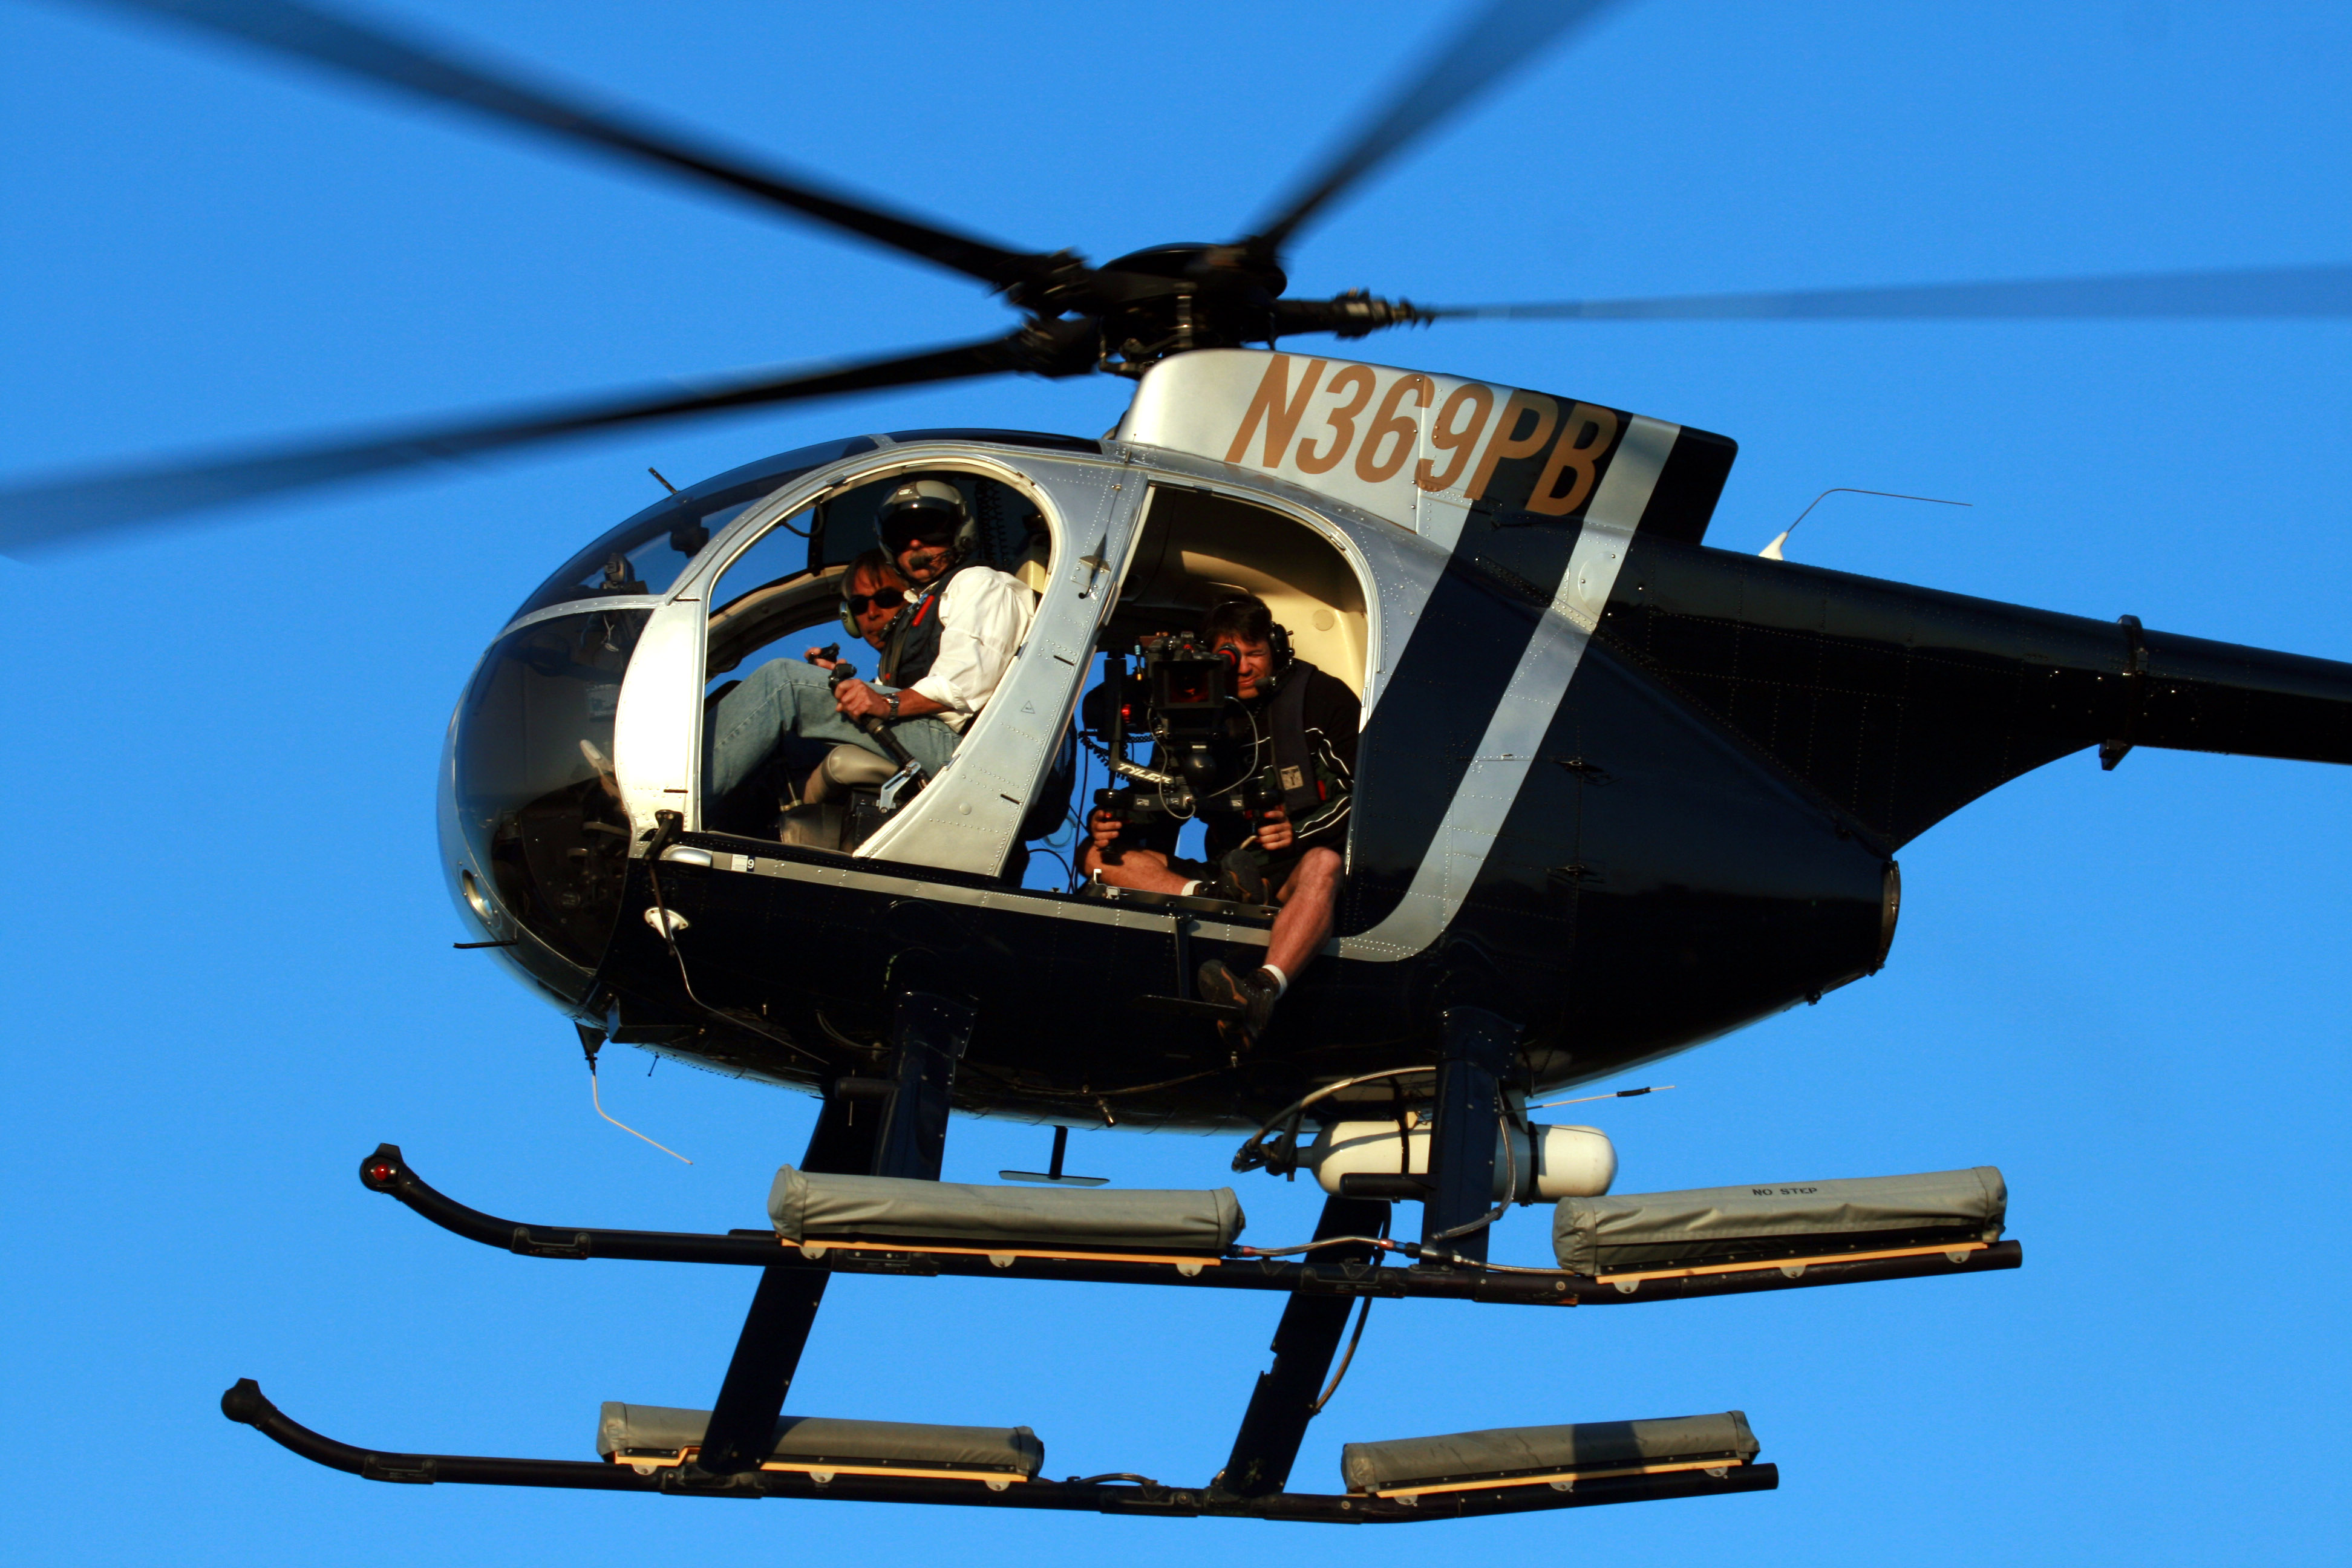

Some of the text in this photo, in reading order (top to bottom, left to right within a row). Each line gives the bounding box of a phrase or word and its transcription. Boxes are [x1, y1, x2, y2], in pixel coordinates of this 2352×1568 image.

[1224, 353, 1618, 516] N369PB
[1118, 763, 1171, 784] TYLER
[748, 859, 754, 869] 9
